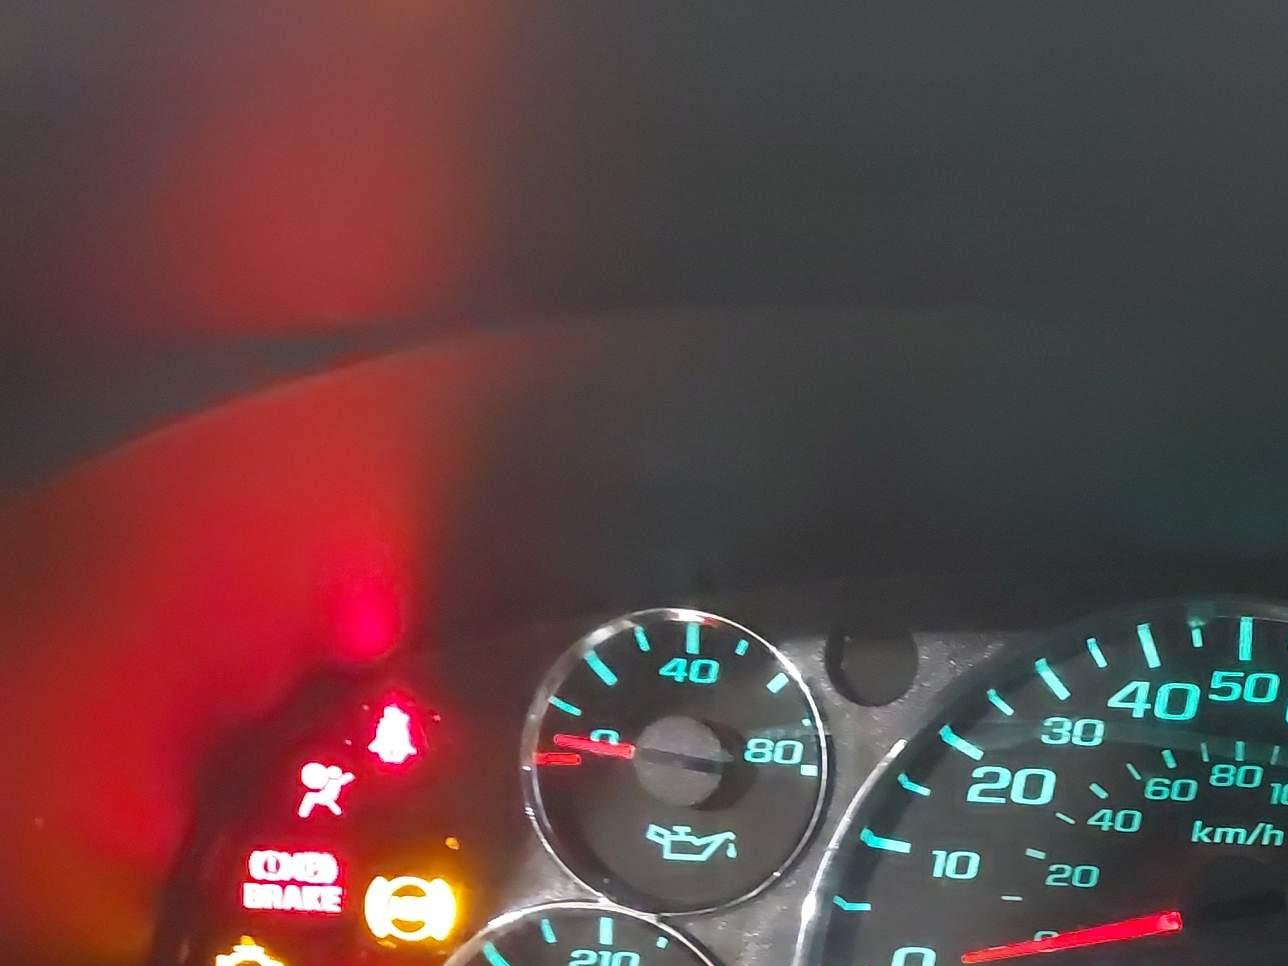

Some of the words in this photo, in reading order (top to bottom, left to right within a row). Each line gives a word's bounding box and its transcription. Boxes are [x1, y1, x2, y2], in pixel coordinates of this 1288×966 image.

[658, 658, 720, 684] 40
[1107, 679, 1200, 721] 40
[1208, 671, 1280, 703] 50
[1040, 718, 1105, 746] 30
[743, 738, 804, 765] 80
[967, 767, 1056, 805] 20
[1144, 778, 1198, 802] 60
[1209, 765, 1263, 789] 80
[1087, 809, 1142, 833] 40
[1192, 819, 1285, 847] km/h
[932, 850, 980, 881] 10
[1045, 864, 1099, 888] 20
[243, 885, 342, 913] BRAKE
